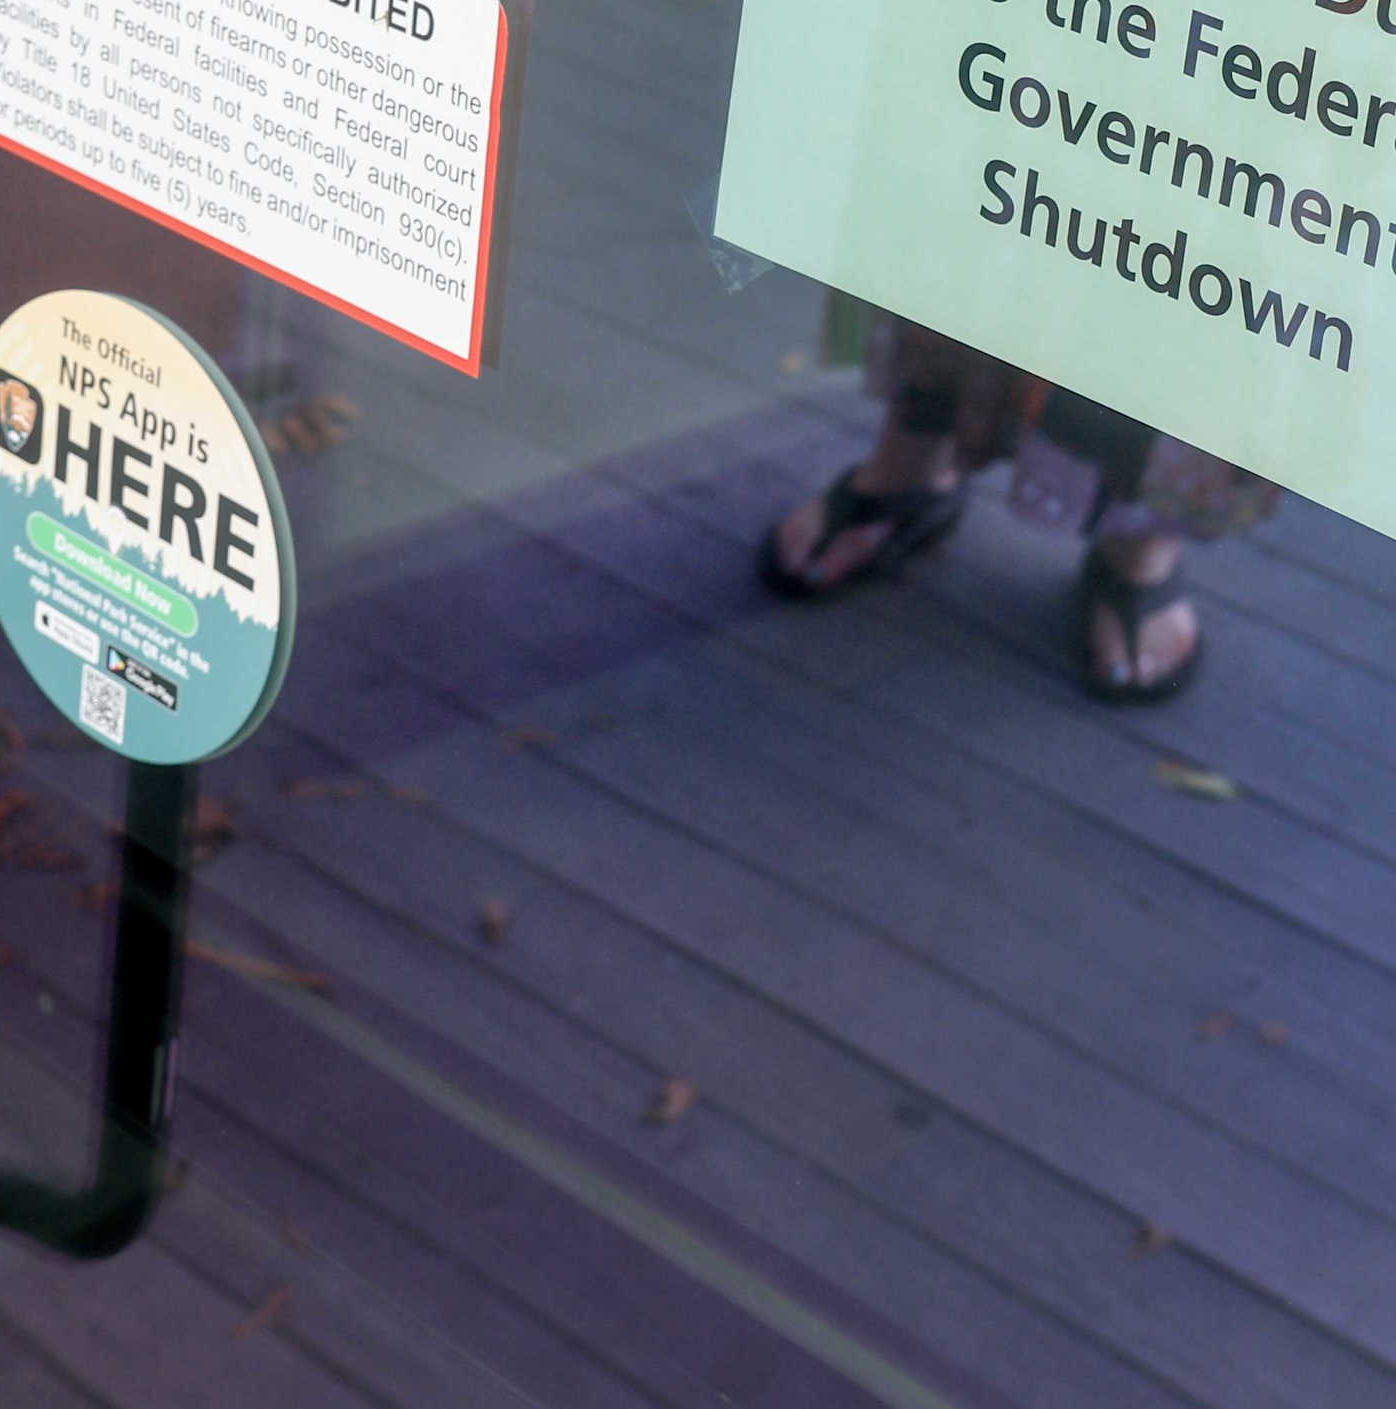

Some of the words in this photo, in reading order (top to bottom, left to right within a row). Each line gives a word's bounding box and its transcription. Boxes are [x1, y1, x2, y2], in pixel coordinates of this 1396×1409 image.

[21, 36, 58, 73] Title
[71, 61, 91, 89] 18
[103, 75, 161, 121] United
[172, 107, 231, 154] States
[243, 140, 298, 188] Code,
[312, 172, 385, 225] Section
[399, 212, 468, 267] 930(c).
[69, 24, 91, 57] by
[99, 43, 120, 67] all
[129, 57, 202, 104] persons
[212, 95, 242, 123] not
[252, 113, 357, 179] specifically
[367, 166, 473, 228] authorized
[113, 8, 180, 57] Federal
[194, 44, 268, 97] facilities
[282, 90, 319, 121] and
[334, 107, 408, 161] Federal
[423, 153, 477, 192] court
[185, 9, 205, 32] of
[210, 15, 287, 69] firearms
[291, 57, 313, 79] or
[316, 68, 368, 103] other
[371, 89, 479, 153] dangerous
[304, 24, 416, 88] possession
[422, 76, 445, 99] or
[450, 82, 482, 116] the
[13, 108, 77, 152] periods
[82, 141, 104, 167] up
[108, 149, 126, 175] to
[131, 159, 161, 192] five
[166, 177, 192, 211] (5)
[196, 196, 251, 236] years.
[67, 97, 108, 132] shall
[111, 114, 134, 144] be
[137, 132, 203, 177] subject
[206, 160, 225, 186] to
[228, 169, 263, 205] fine
[266, 193, 329, 234] and/or
[332, 218, 467, 303] imprisonment
[979, 159, 1353, 373] Shutdown
[60, 355, 112, 410] NPS
[120, 392, 177, 451] App
[188, 424, 209, 463] is
[61, 316, 91, 353] The
[97, 337, 163, 389] Official
[53, 404, 260, 593] HERE
[54, 533, 133, 593] Download
[135, 580, 172, 616] Now
